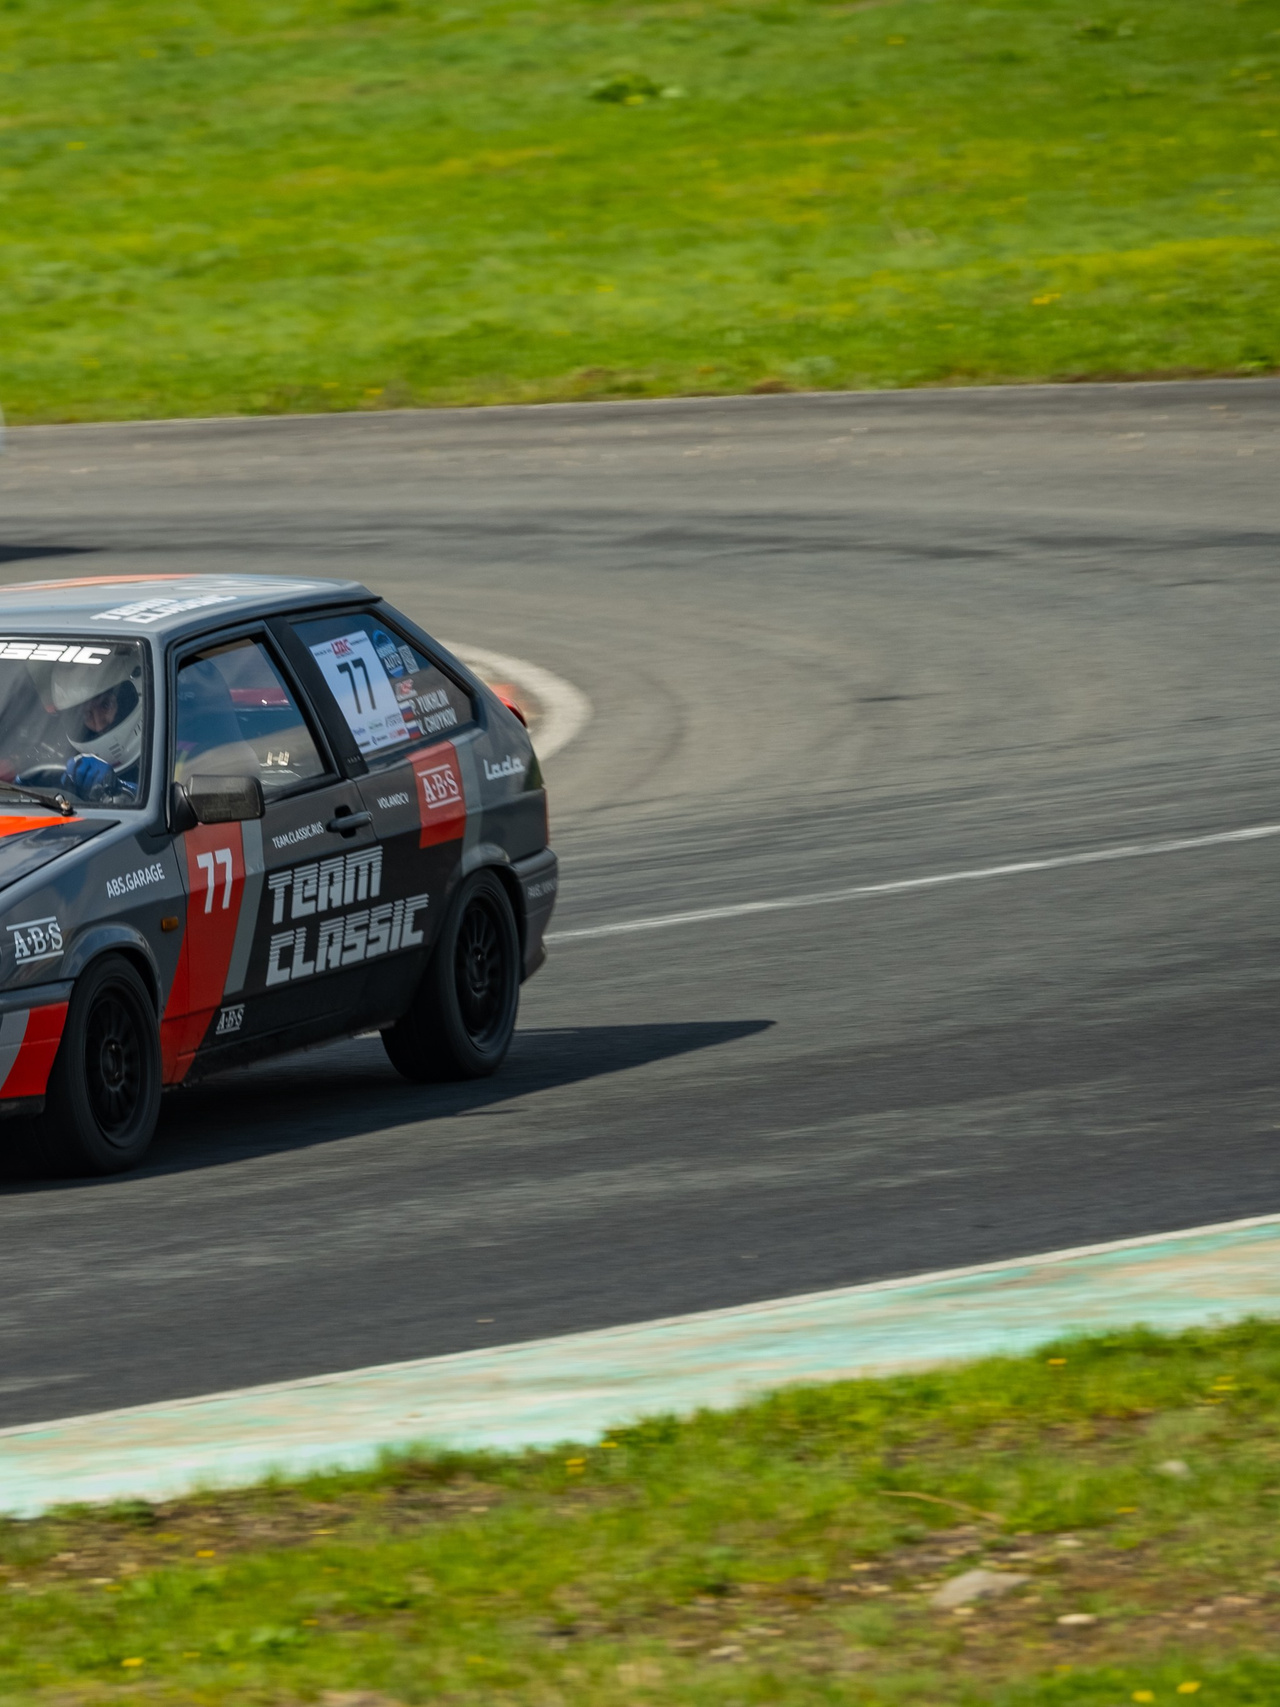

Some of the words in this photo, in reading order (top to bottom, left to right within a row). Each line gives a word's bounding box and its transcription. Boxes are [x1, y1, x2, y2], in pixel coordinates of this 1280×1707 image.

[336, 657, 378, 715] 77
[483, 754, 526, 782] Lada
[271, 820, 325, 850] TEAM.CLASSIC.RUS
[106, 862, 166, 899] ABS.GARAGE
[196, 847, 233, 914] 77
[267, 845, 384, 925] TEAM
[265, 893, 430, 988] CLASSIC
